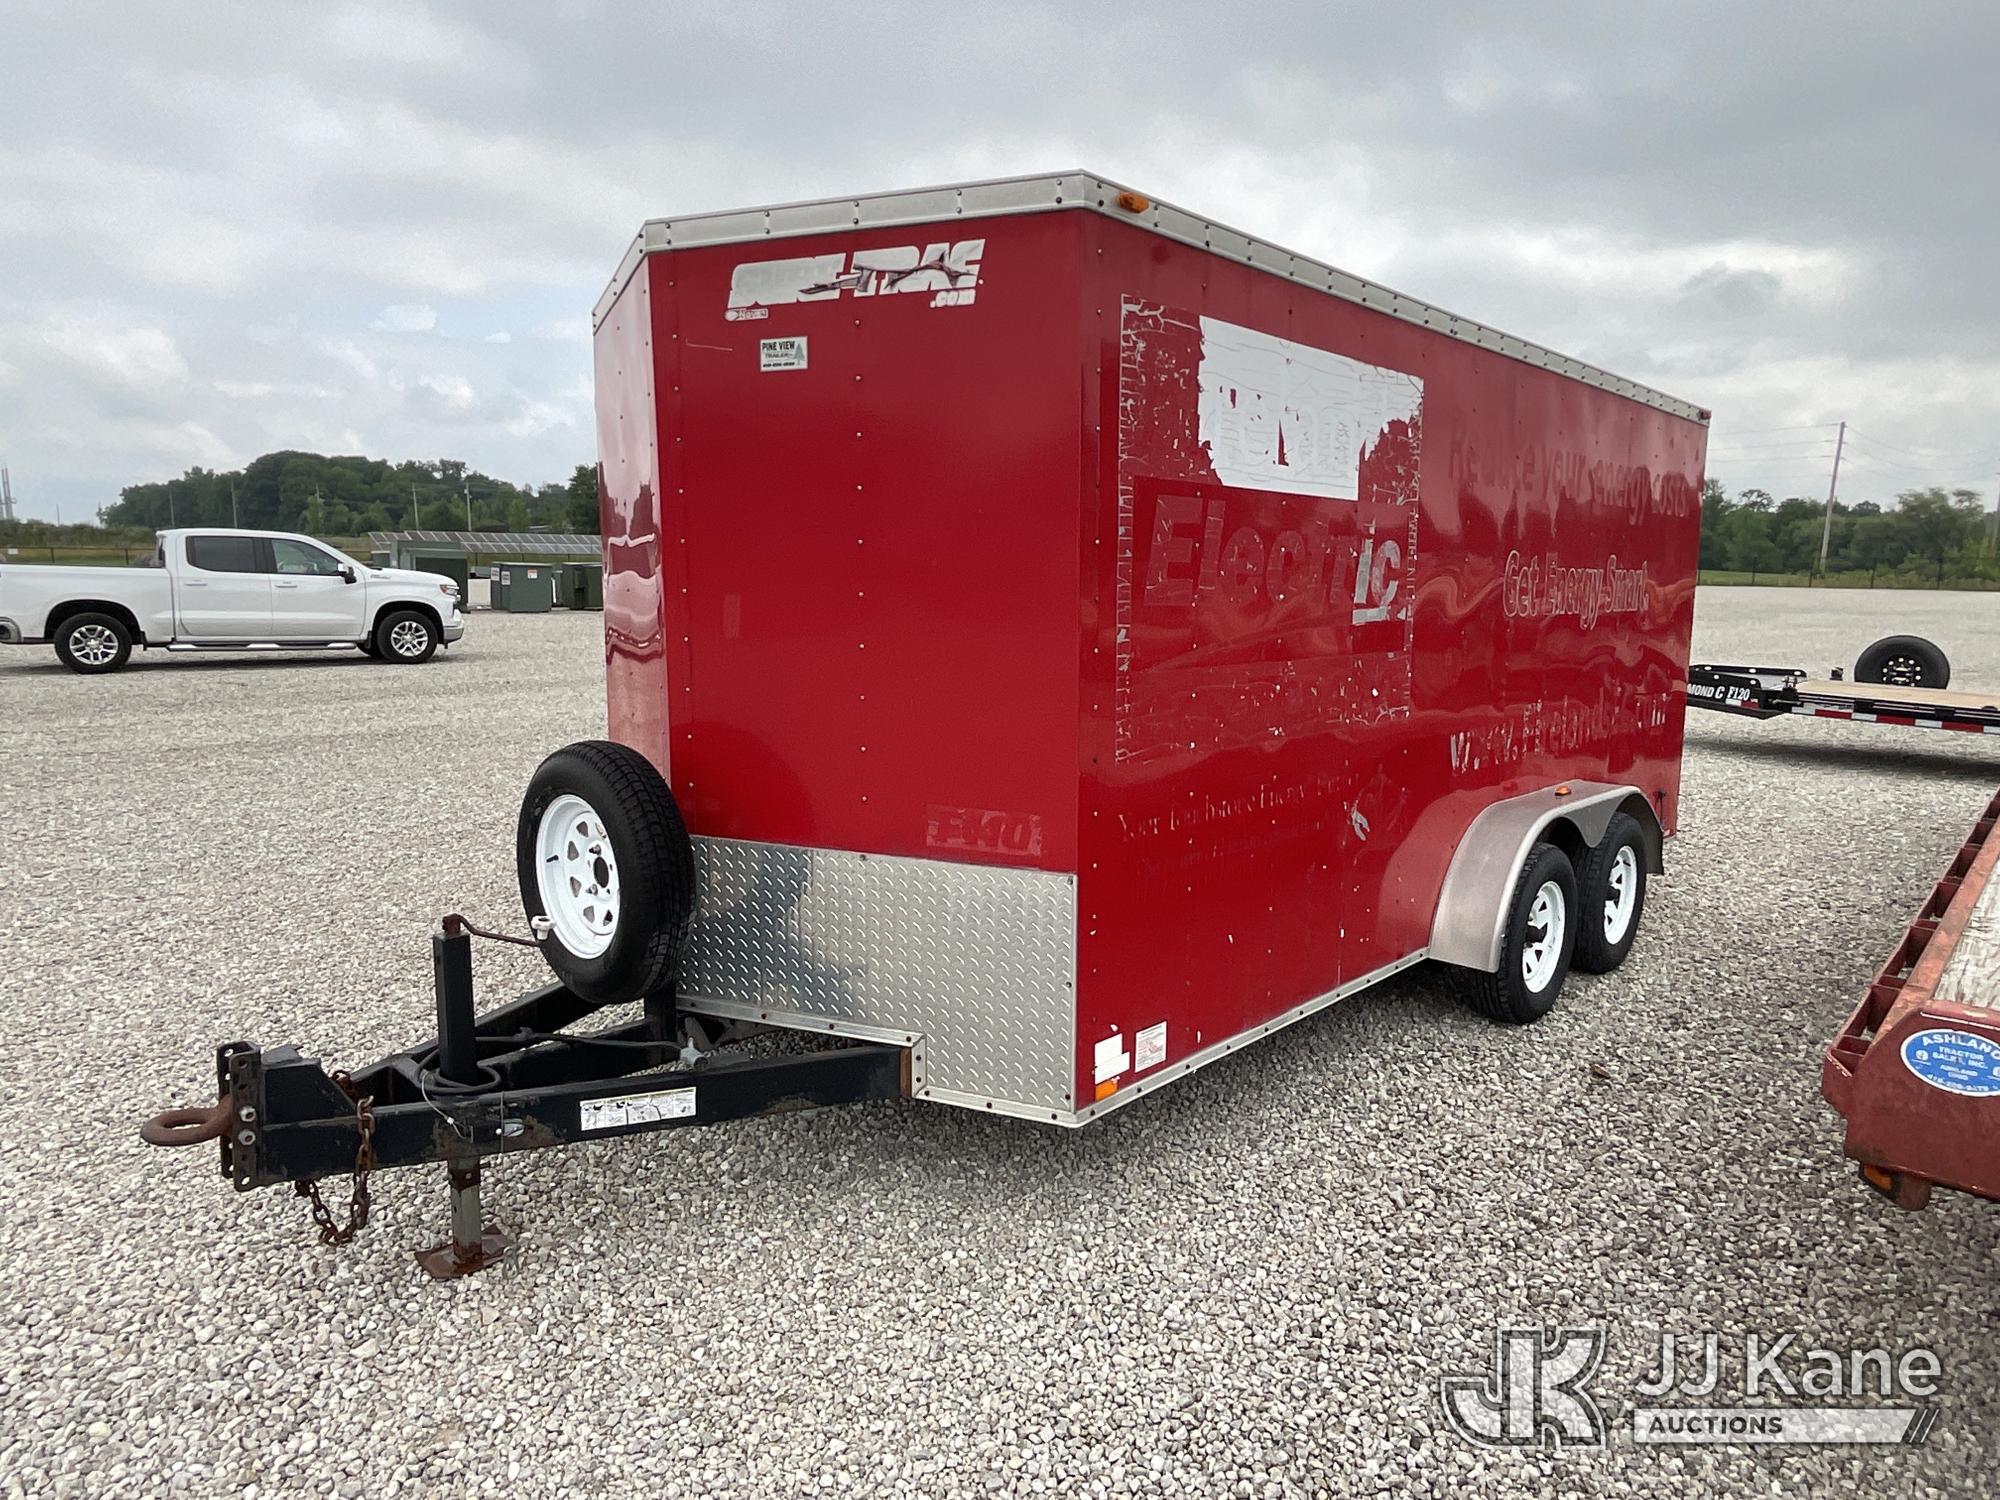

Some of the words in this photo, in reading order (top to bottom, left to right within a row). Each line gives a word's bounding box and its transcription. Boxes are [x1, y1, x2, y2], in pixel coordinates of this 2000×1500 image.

[762, 342, 777, 351] PINE
[778, 340, 796, 350] VIEW
[1503, 550, 1539, 617] Get
[1715, 686, 1725, 699] C
[1727, 686, 1751, 701] F120
[1939, 1046, 1984, 1061] TRACTOR
